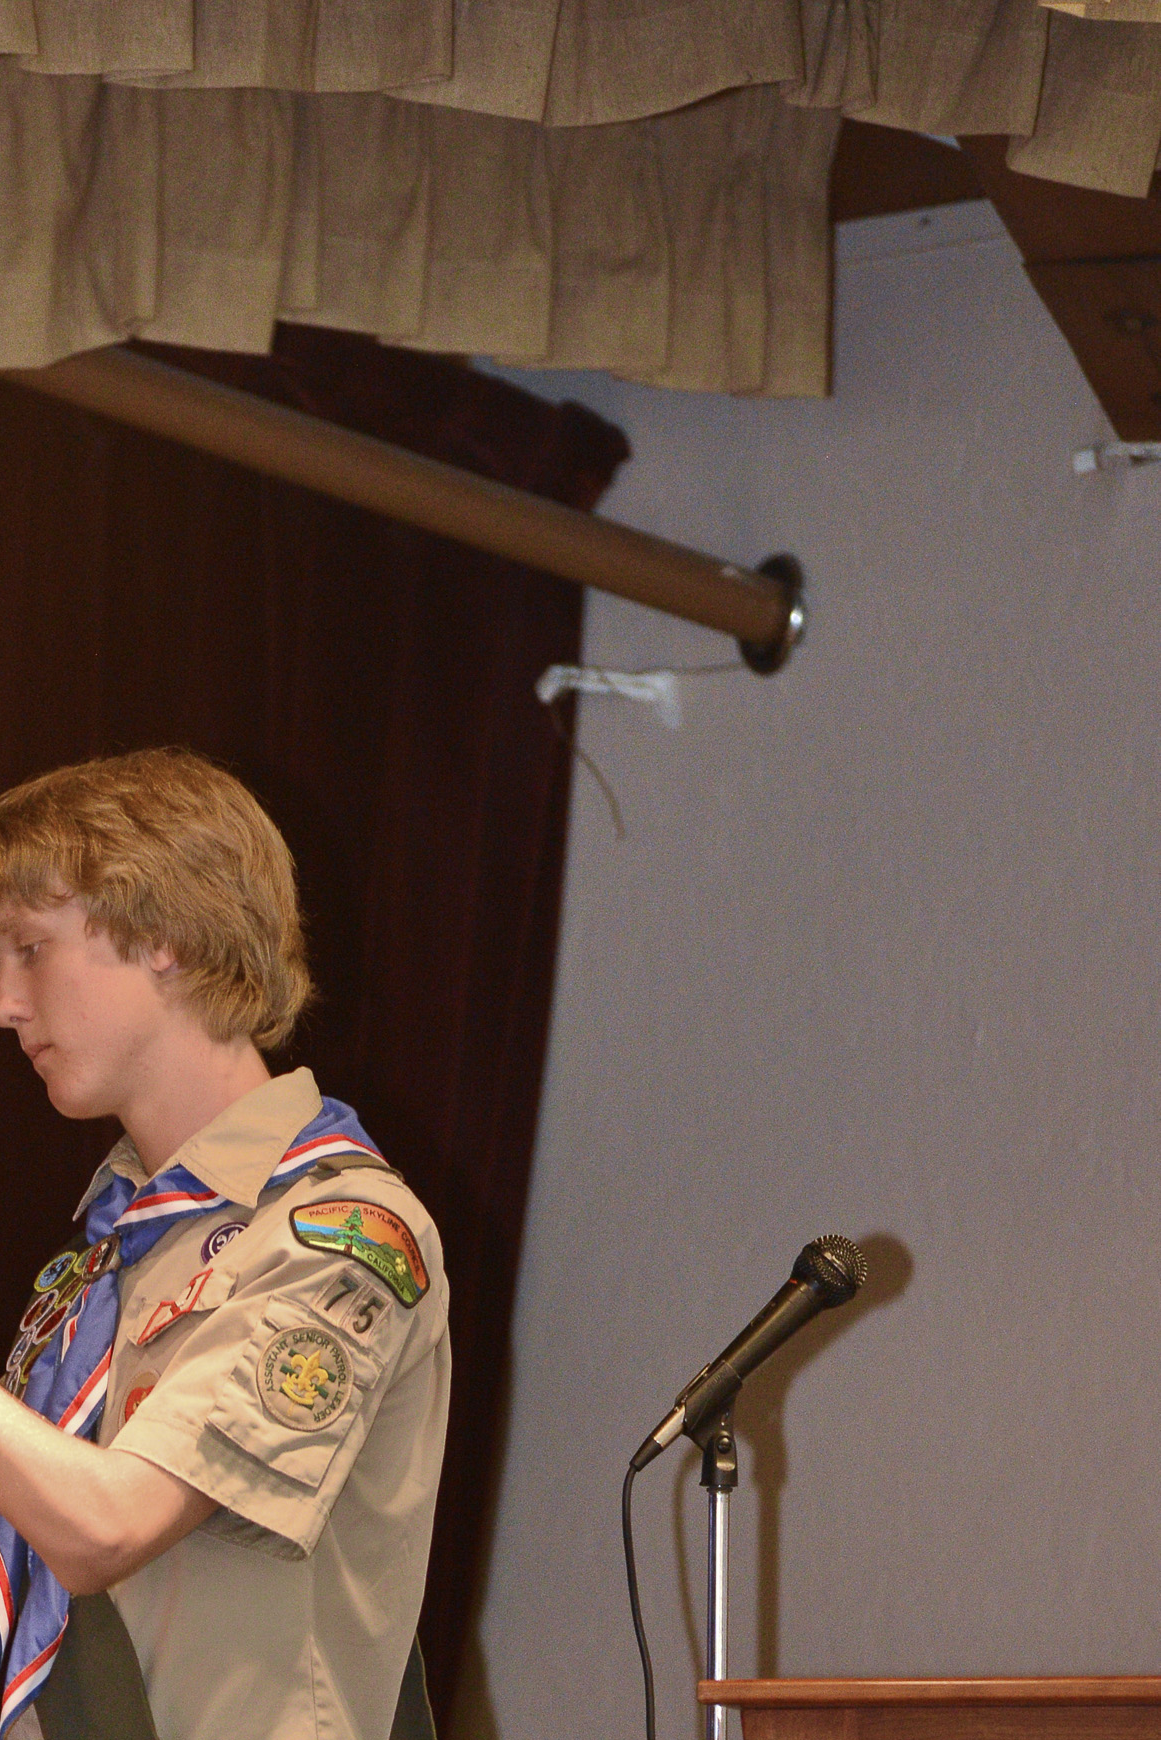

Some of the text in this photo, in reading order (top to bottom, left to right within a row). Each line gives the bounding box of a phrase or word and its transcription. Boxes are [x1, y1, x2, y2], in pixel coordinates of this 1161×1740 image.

[308, 1205, 349, 1218] PACIFIC
[362, 1206, 401, 1233] SKYLINE
[323, 1275, 384, 1334] 75
[264, 1331, 347, 1423] ASSISTANT SENIOR PATROL LEADER
